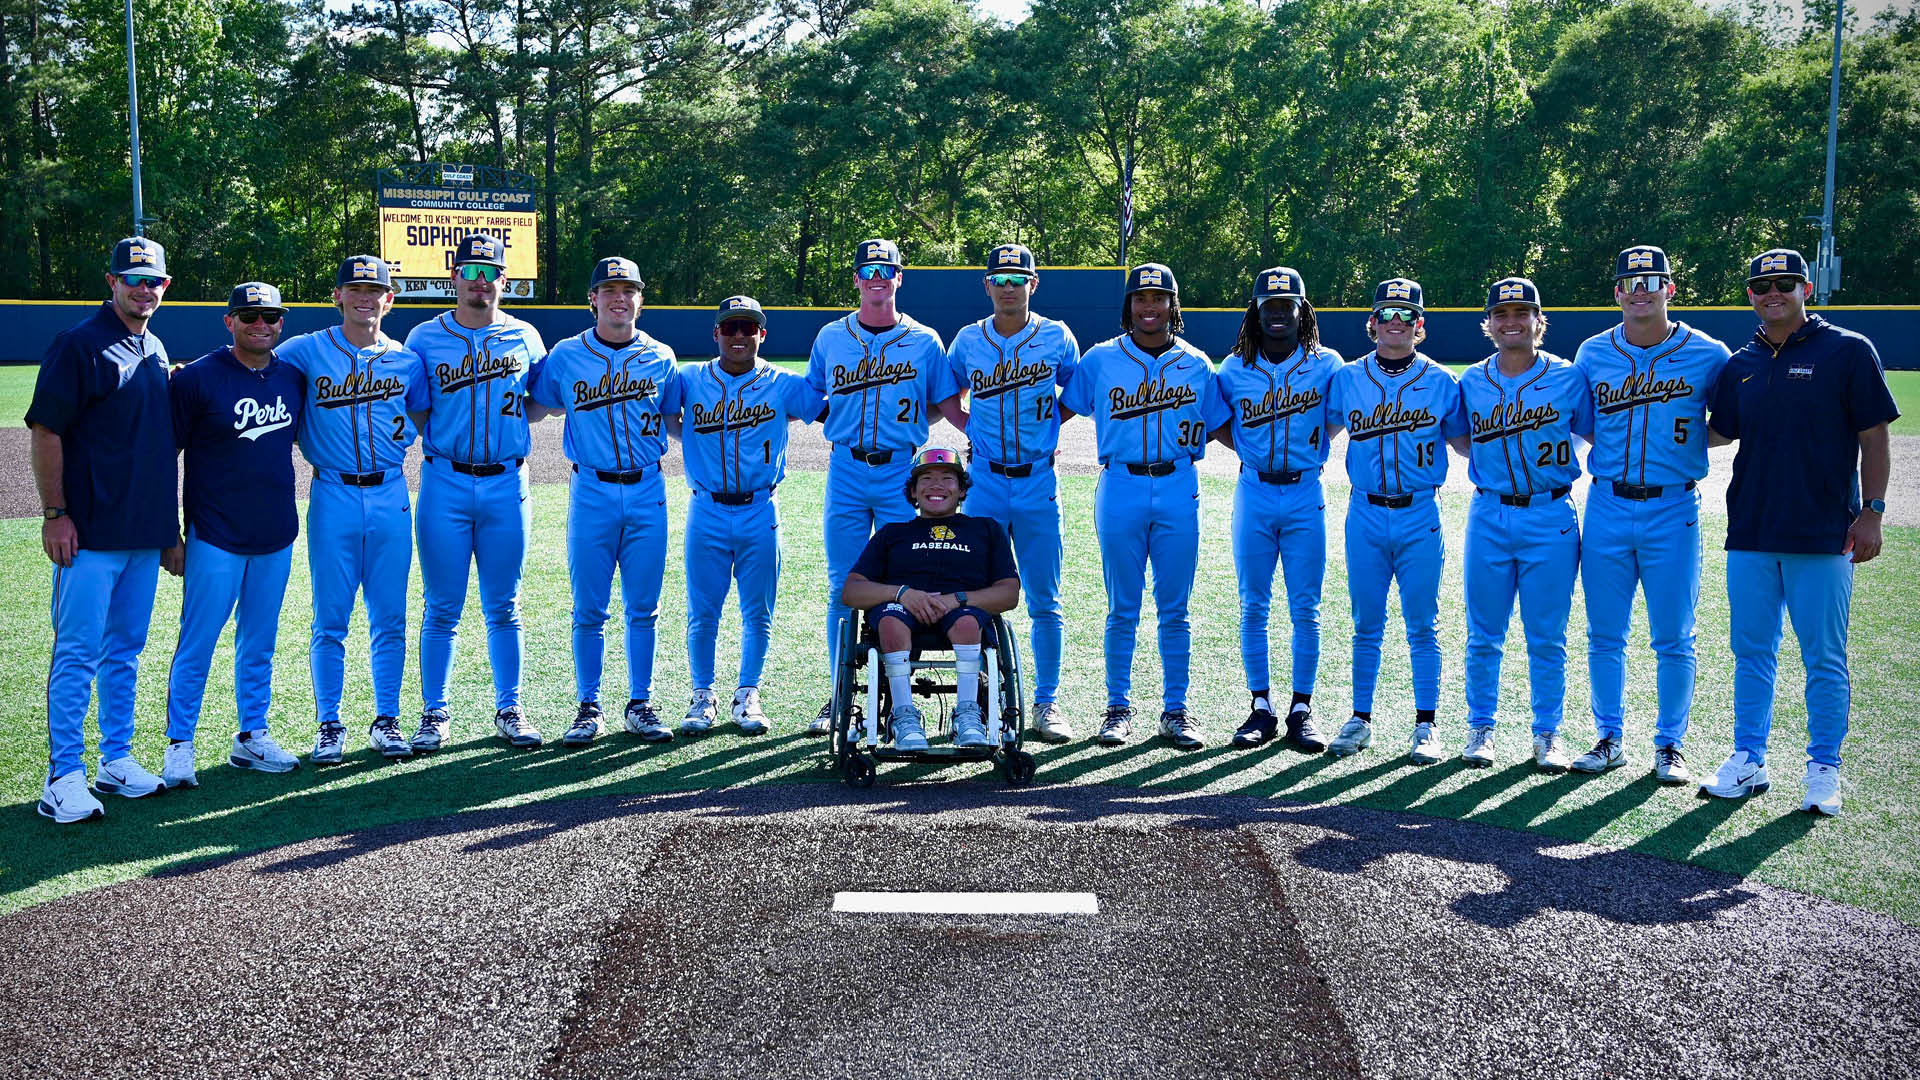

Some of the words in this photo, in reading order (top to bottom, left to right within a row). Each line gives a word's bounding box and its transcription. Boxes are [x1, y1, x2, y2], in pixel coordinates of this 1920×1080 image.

[383, 188, 454, 199] MISSISSIPPI
[458, 191, 489, 201] GULF
[492, 192, 530, 203] COAST
[411, 200, 464, 209] COMMUNITY
[467, 202, 505, 210] COLLEGE
[384, 213, 421, 223] WELCOME
[425, 215, 433, 223] TO
[436, 215, 450, 224] KEN
[487, 216, 511, 226] FARRIS
[513, 217, 533, 226] FIELD
[405, 280, 427, 292] KEN
[435, 351, 521, 386] Bulldogs
[833, 356, 916, 389] Bulldogs
[971, 359, 1052, 393] Bulldogs
[315, 371, 404, 402] Bulldogs
[573, 371, 656, 405] Bulldogs
[1109, 379, 1196, 413] Bulldogs
[1595, 371, 1693, 407] Bulldogs
[233, 395, 292, 432] Perk
[692, 400, 776, 428] Bulldogs
[896, 398, 919, 424] 21
[1036, 395, 1053, 421] 12
[1240, 385, 1322, 421] Bulldogs
[392, 416, 405, 440] 2
[641, 413, 661, 436] 23
[1349, 401, 1437, 435] Bulldogs
[1472, 400, 1559, 436] Bulldogs
[1674, 417, 1689, 444] 5
[1177, 421, 1205, 447] 30
[1309, 426, 1319, 450] 4
[763, 440, 770, 464] 1
[1416, 442, 1435, 468] 19
[1536, 441, 1570, 467] 20
[911, 542, 971, 553] BASEBALL
